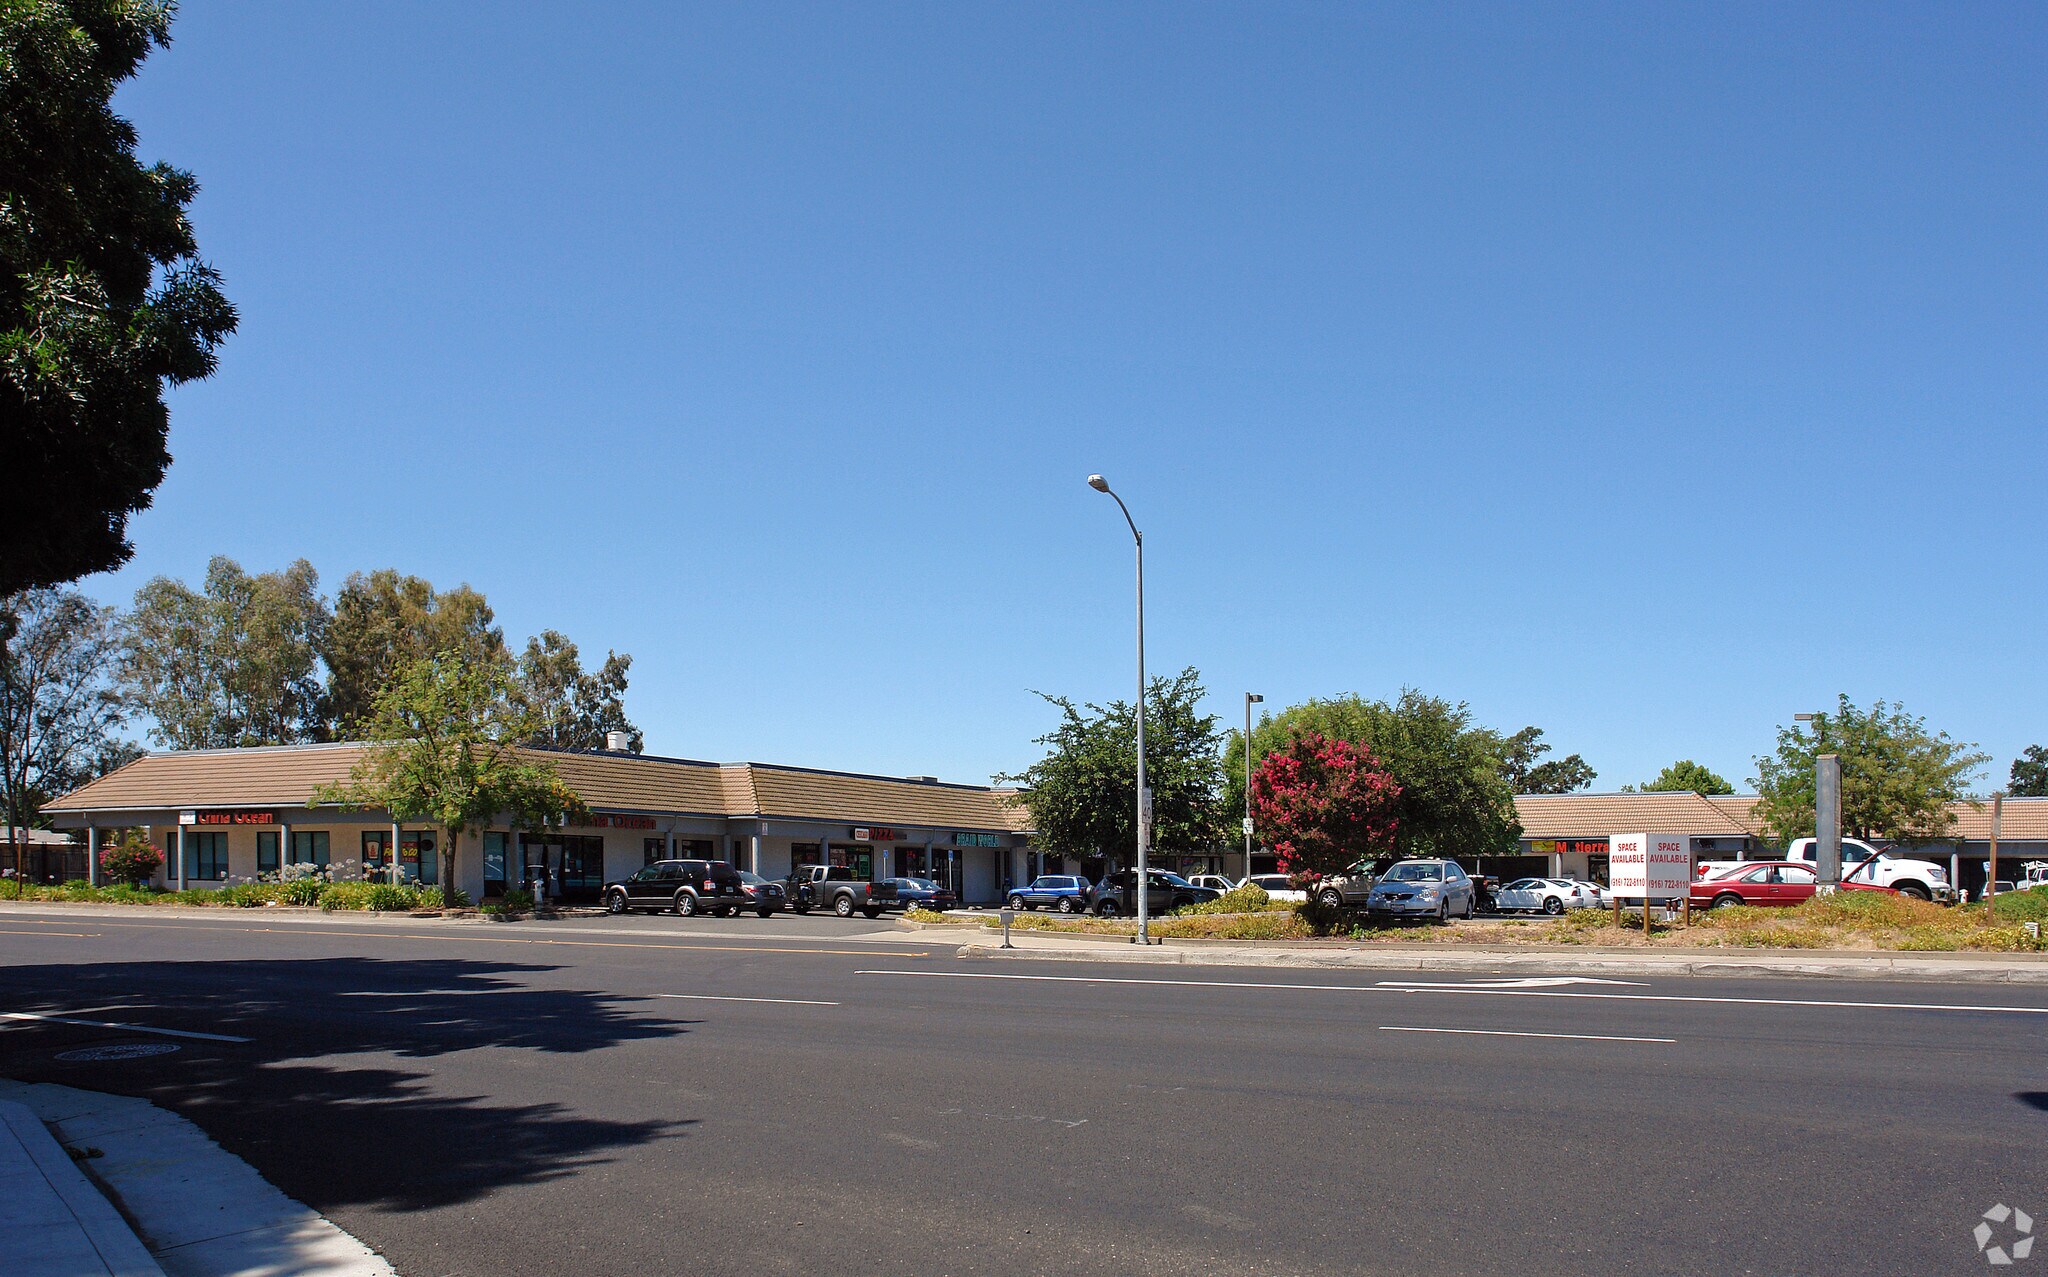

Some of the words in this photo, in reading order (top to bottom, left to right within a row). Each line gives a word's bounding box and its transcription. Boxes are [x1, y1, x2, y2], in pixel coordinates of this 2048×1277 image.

[234, 811, 273, 824] Ocean
[614, 814, 656, 830] Ocean
[869, 826, 895, 841] PIZZA
[977, 834, 1000, 848] WORLD
[1617, 842, 1638, 852] SPACE
[1657, 842, 1681, 852] SPACE
[1611, 854, 1645, 864] AVAILABLE
[1649, 854, 1688, 864] AVAILABLE
[1664, 879, 1689, 889] 722-8110
